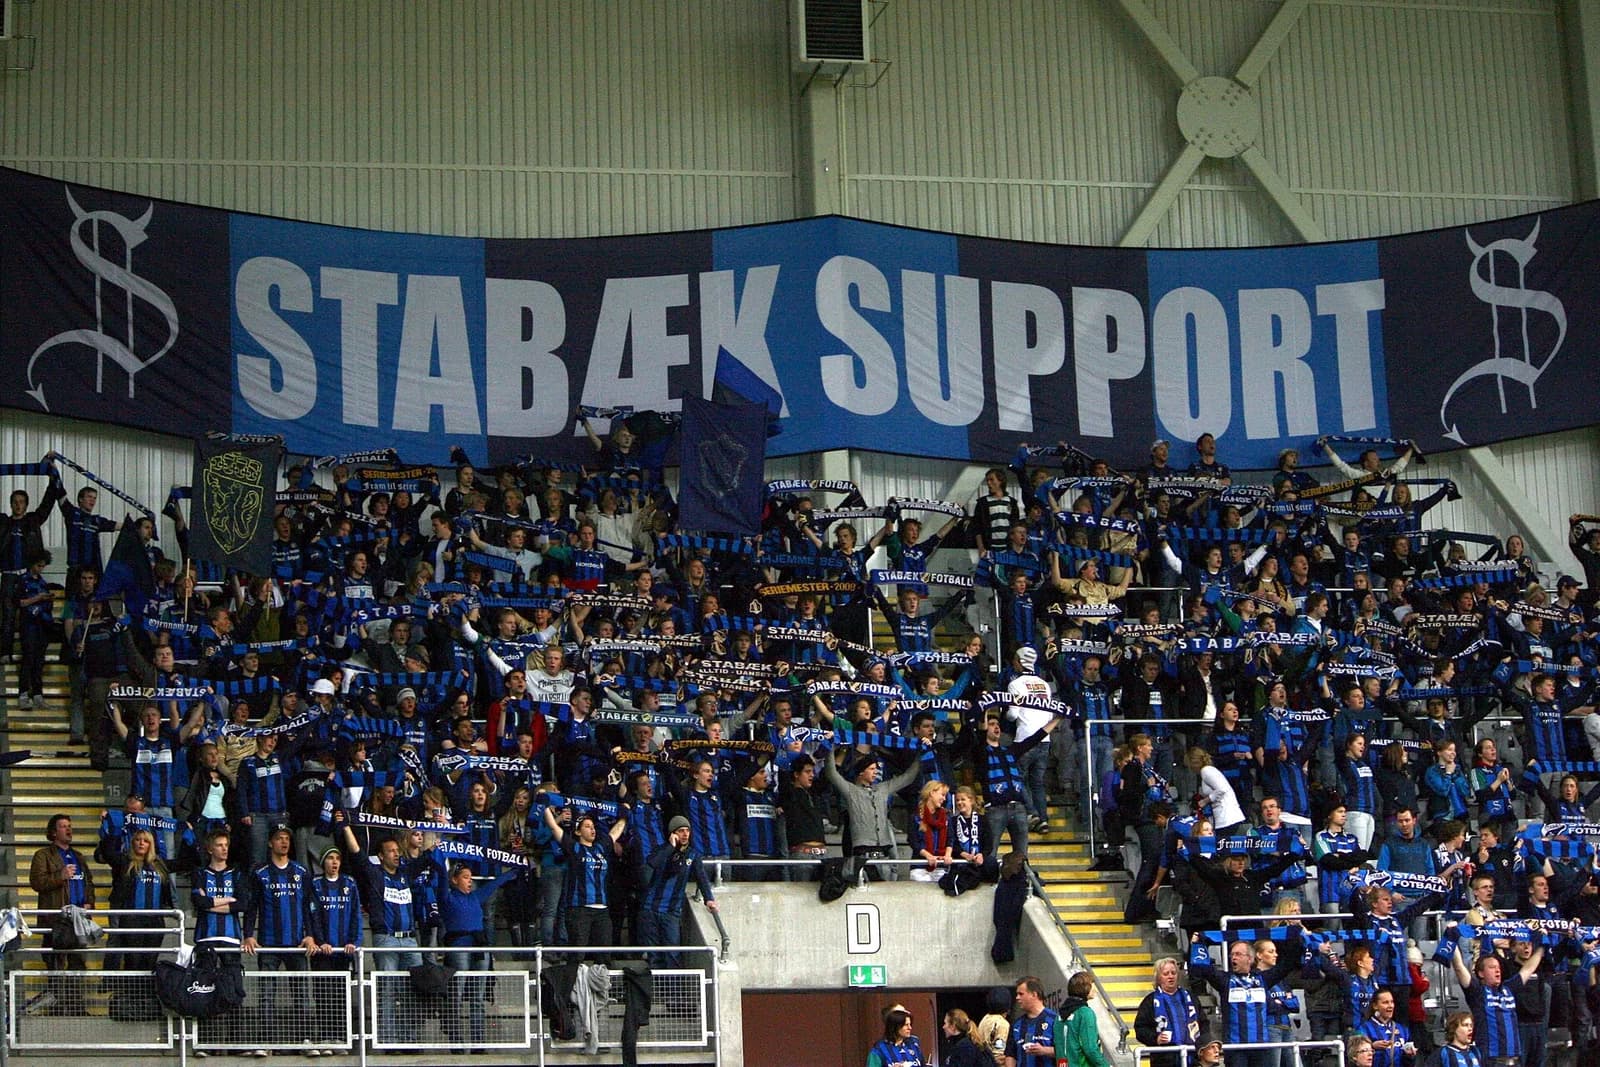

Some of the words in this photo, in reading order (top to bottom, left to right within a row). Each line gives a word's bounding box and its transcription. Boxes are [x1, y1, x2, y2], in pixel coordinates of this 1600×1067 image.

[235, 256, 784, 438] STABÆK
[815, 255, 1385, 441] SUPPORT
[339, 455, 389, 464] FOTBALL
[768, 480, 810, 492] STABÆK
[878, 571, 922, 583] STABÆK
[930, 573, 973, 587] FOTBALL
[761, 582, 828, 596] SERIEMESTER
[1417, 614, 1480, 624] STABÆK
[768, 627, 831, 637] STABÆK
[499, 653, 520, 661] ordea
[701, 660, 771, 672] STABÆK
[807, 681, 847, 693] STABÆK
[1288, 713, 1331, 721] FOTBALL
[253, 717, 310, 737] FOTBALL
[107, 785, 120, 797] 15
[124, 812, 148, 826] Fram
[148, 815, 157, 828] til
[358, 812, 403, 826] STABÆK
[1216, 838, 1242, 851] Fram
[1243, 837, 1254, 849] til
[1254, 839, 1277, 850] seier
[439, 841, 484, 858] STABÆK
[486, 847, 529, 866] FOTBALL
[1392, 878, 1447, 892] FOTBALL
[1393, 872, 1447, 887] STABÆK
[319, 895, 351, 903] ORNEBU
[845, 903, 882, 955] D
